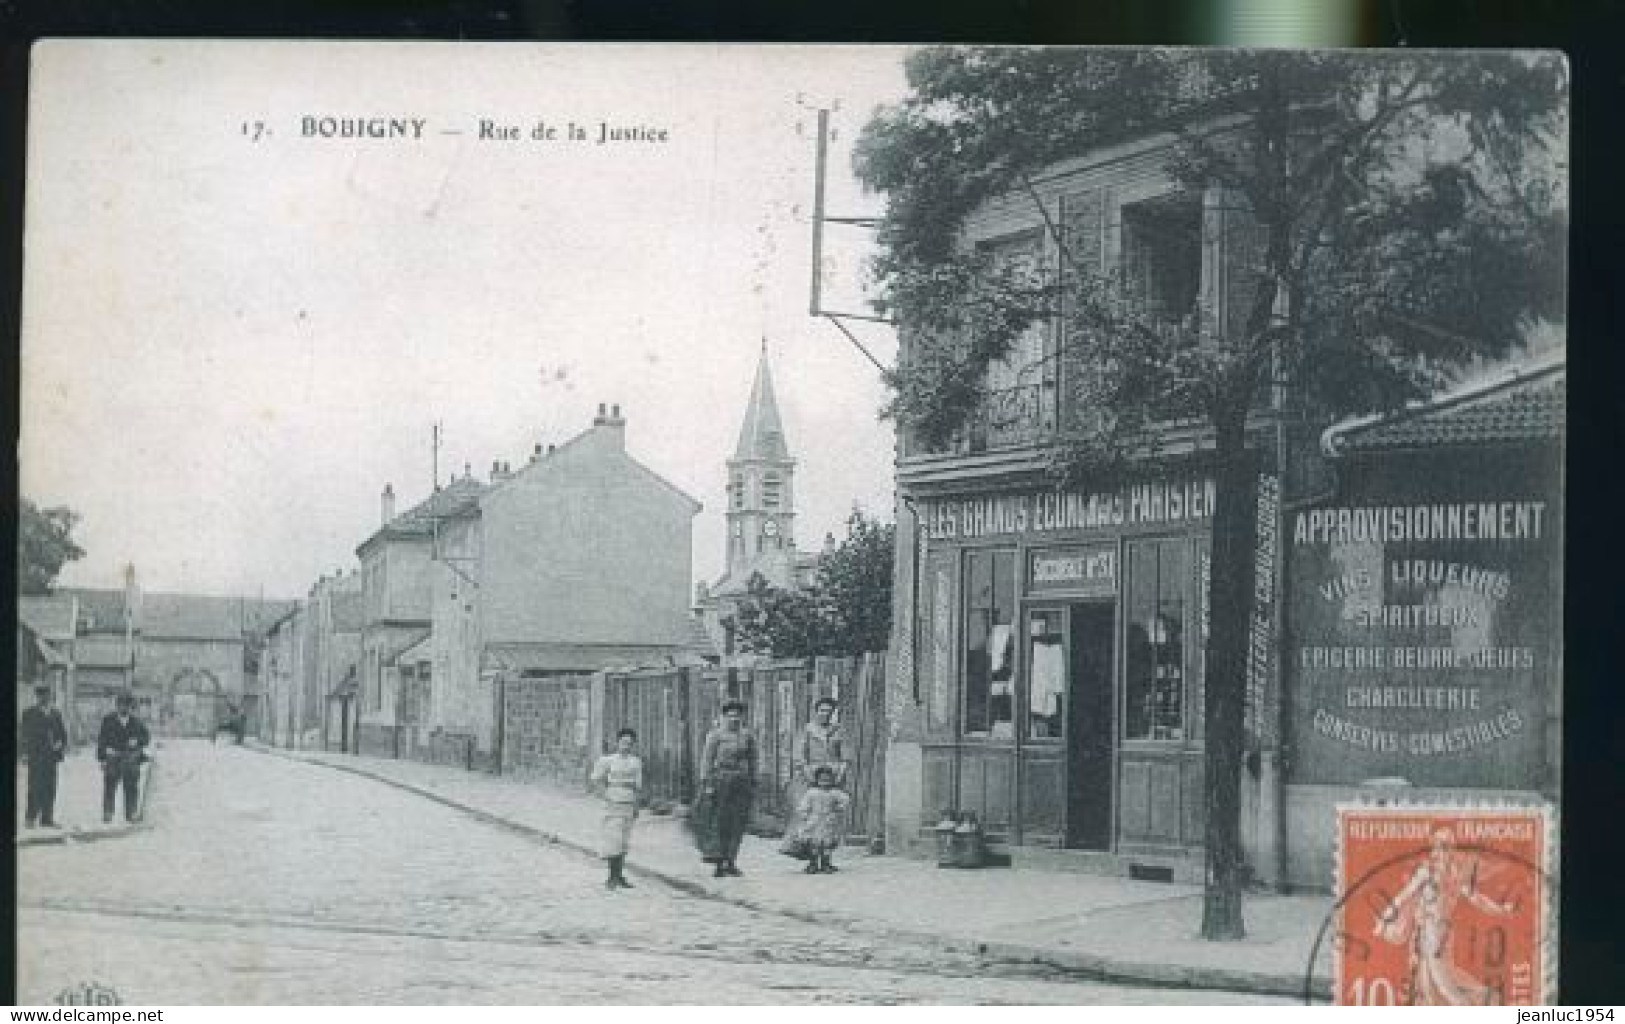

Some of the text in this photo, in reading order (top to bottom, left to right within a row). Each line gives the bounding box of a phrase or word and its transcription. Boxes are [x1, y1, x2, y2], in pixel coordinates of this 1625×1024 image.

[929, 499, 956, 538] LES
[1294, 502, 1546, 544] APPROVISIONNEMENT
[1391, 559, 1511, 600] LIQUEURS
[1355, 603, 1478, 627] SPIRITUEUX
[1347, 685, 1480, 710] CHARCUTERIE
